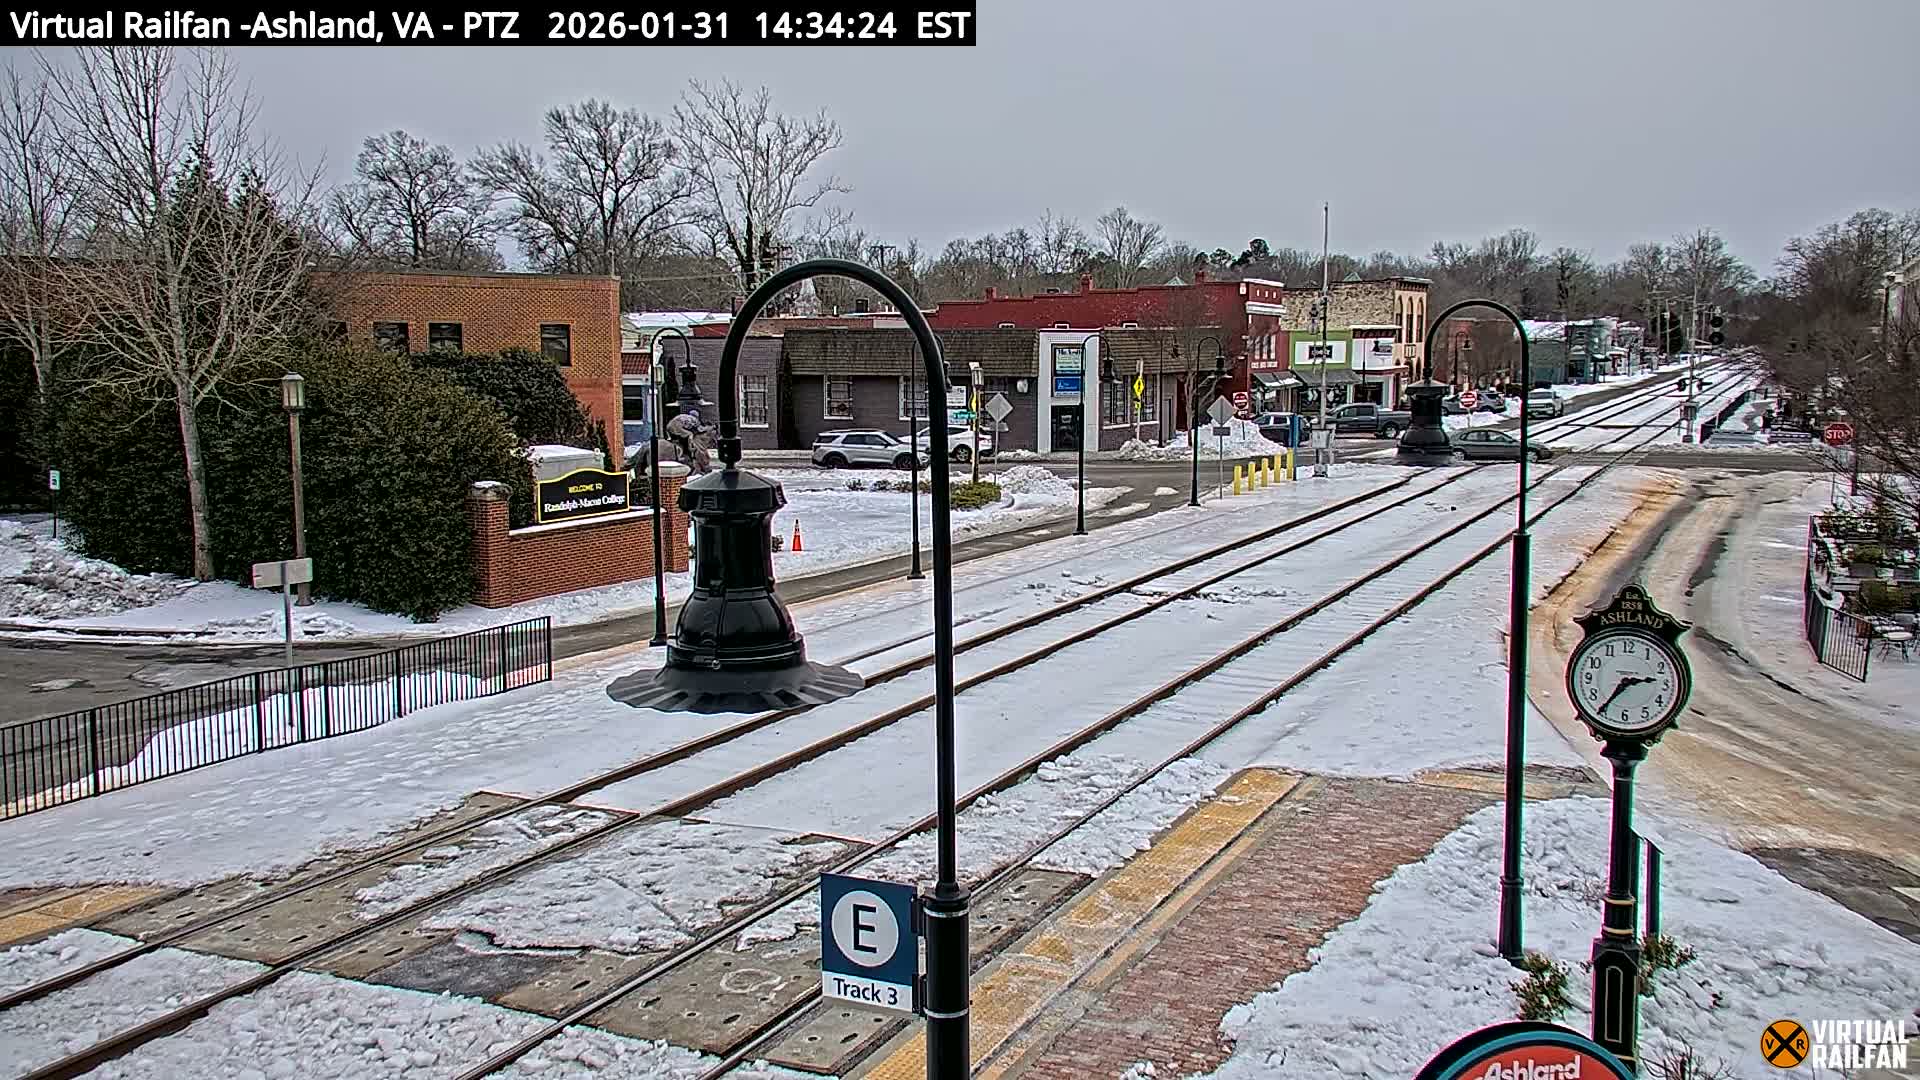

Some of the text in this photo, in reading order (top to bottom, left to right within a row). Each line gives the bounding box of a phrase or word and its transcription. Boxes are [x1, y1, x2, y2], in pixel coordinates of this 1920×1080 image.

[1826, 429, 1851, 440] STOP
[601, 494, 626, 505] College
[1600, 611, 1664, 629] ASHLAND
[1605, 644, 1614, 657] 11
[1623, 641, 1635, 654] 12
[1645, 648, 1650, 660] 1
[1590, 656, 1601, 669] 10
[1657, 661, 1665, 674] 2
[1584, 672, 1592, 684] 9
[1662, 679, 1669, 691] 3
[1589, 688, 1598, 701] 8
[1655, 694, 1663, 707] 4
[1621, 709, 1628, 721] 6
[1641, 707, 1649, 719] 5
[852, 903, 877, 954] E
[833, 977, 898, 1006] Track 3
[1483, 1055, 1580, 1080] Ashland
